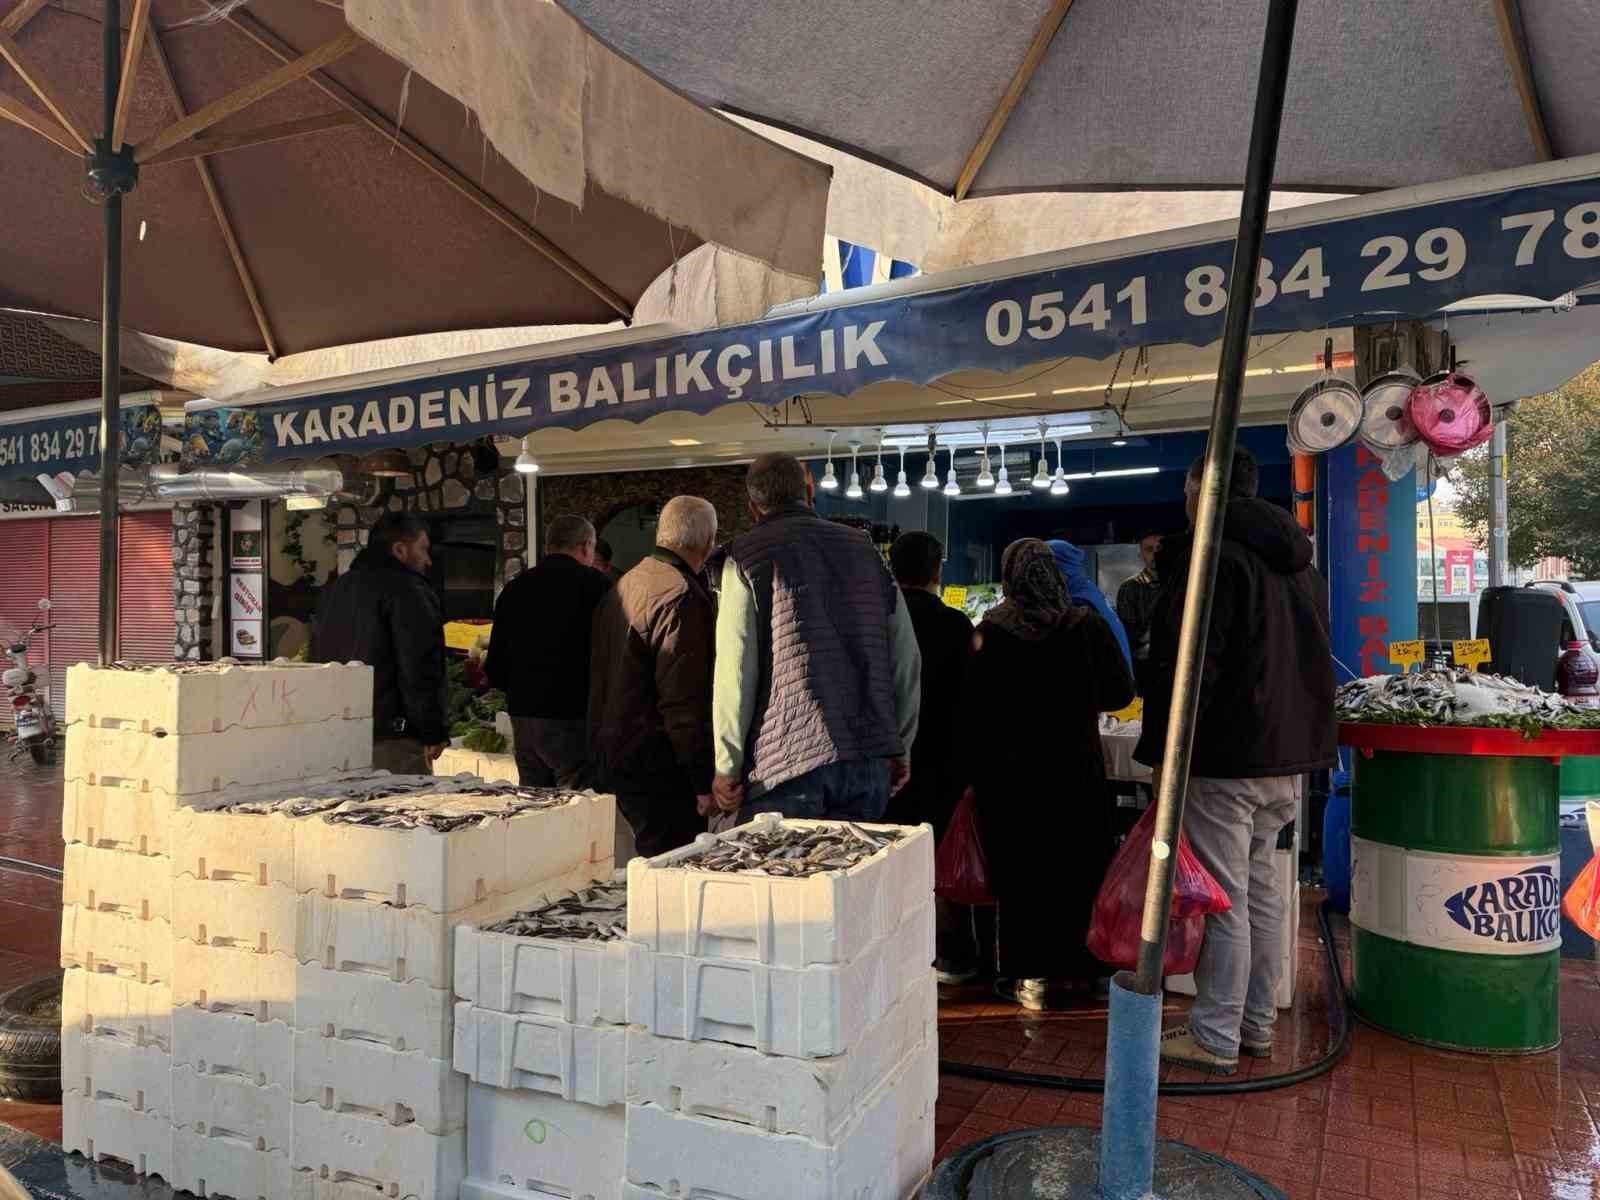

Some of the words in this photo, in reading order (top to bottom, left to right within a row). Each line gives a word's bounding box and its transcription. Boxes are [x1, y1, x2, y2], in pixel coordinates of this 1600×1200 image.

[985, 276, 1147, 347] 0541
[1184, 247, 1330, 317] 834
[1360, 227, 1467, 293] 29
[1501, 201, 1600, 266] 78
[31, 430, 61, 463] 834
[65, 427, 84, 459] 29
[273, 373, 532, 448] KARADENİZ
[549, 320, 888, 414] BALIKÇILIK
